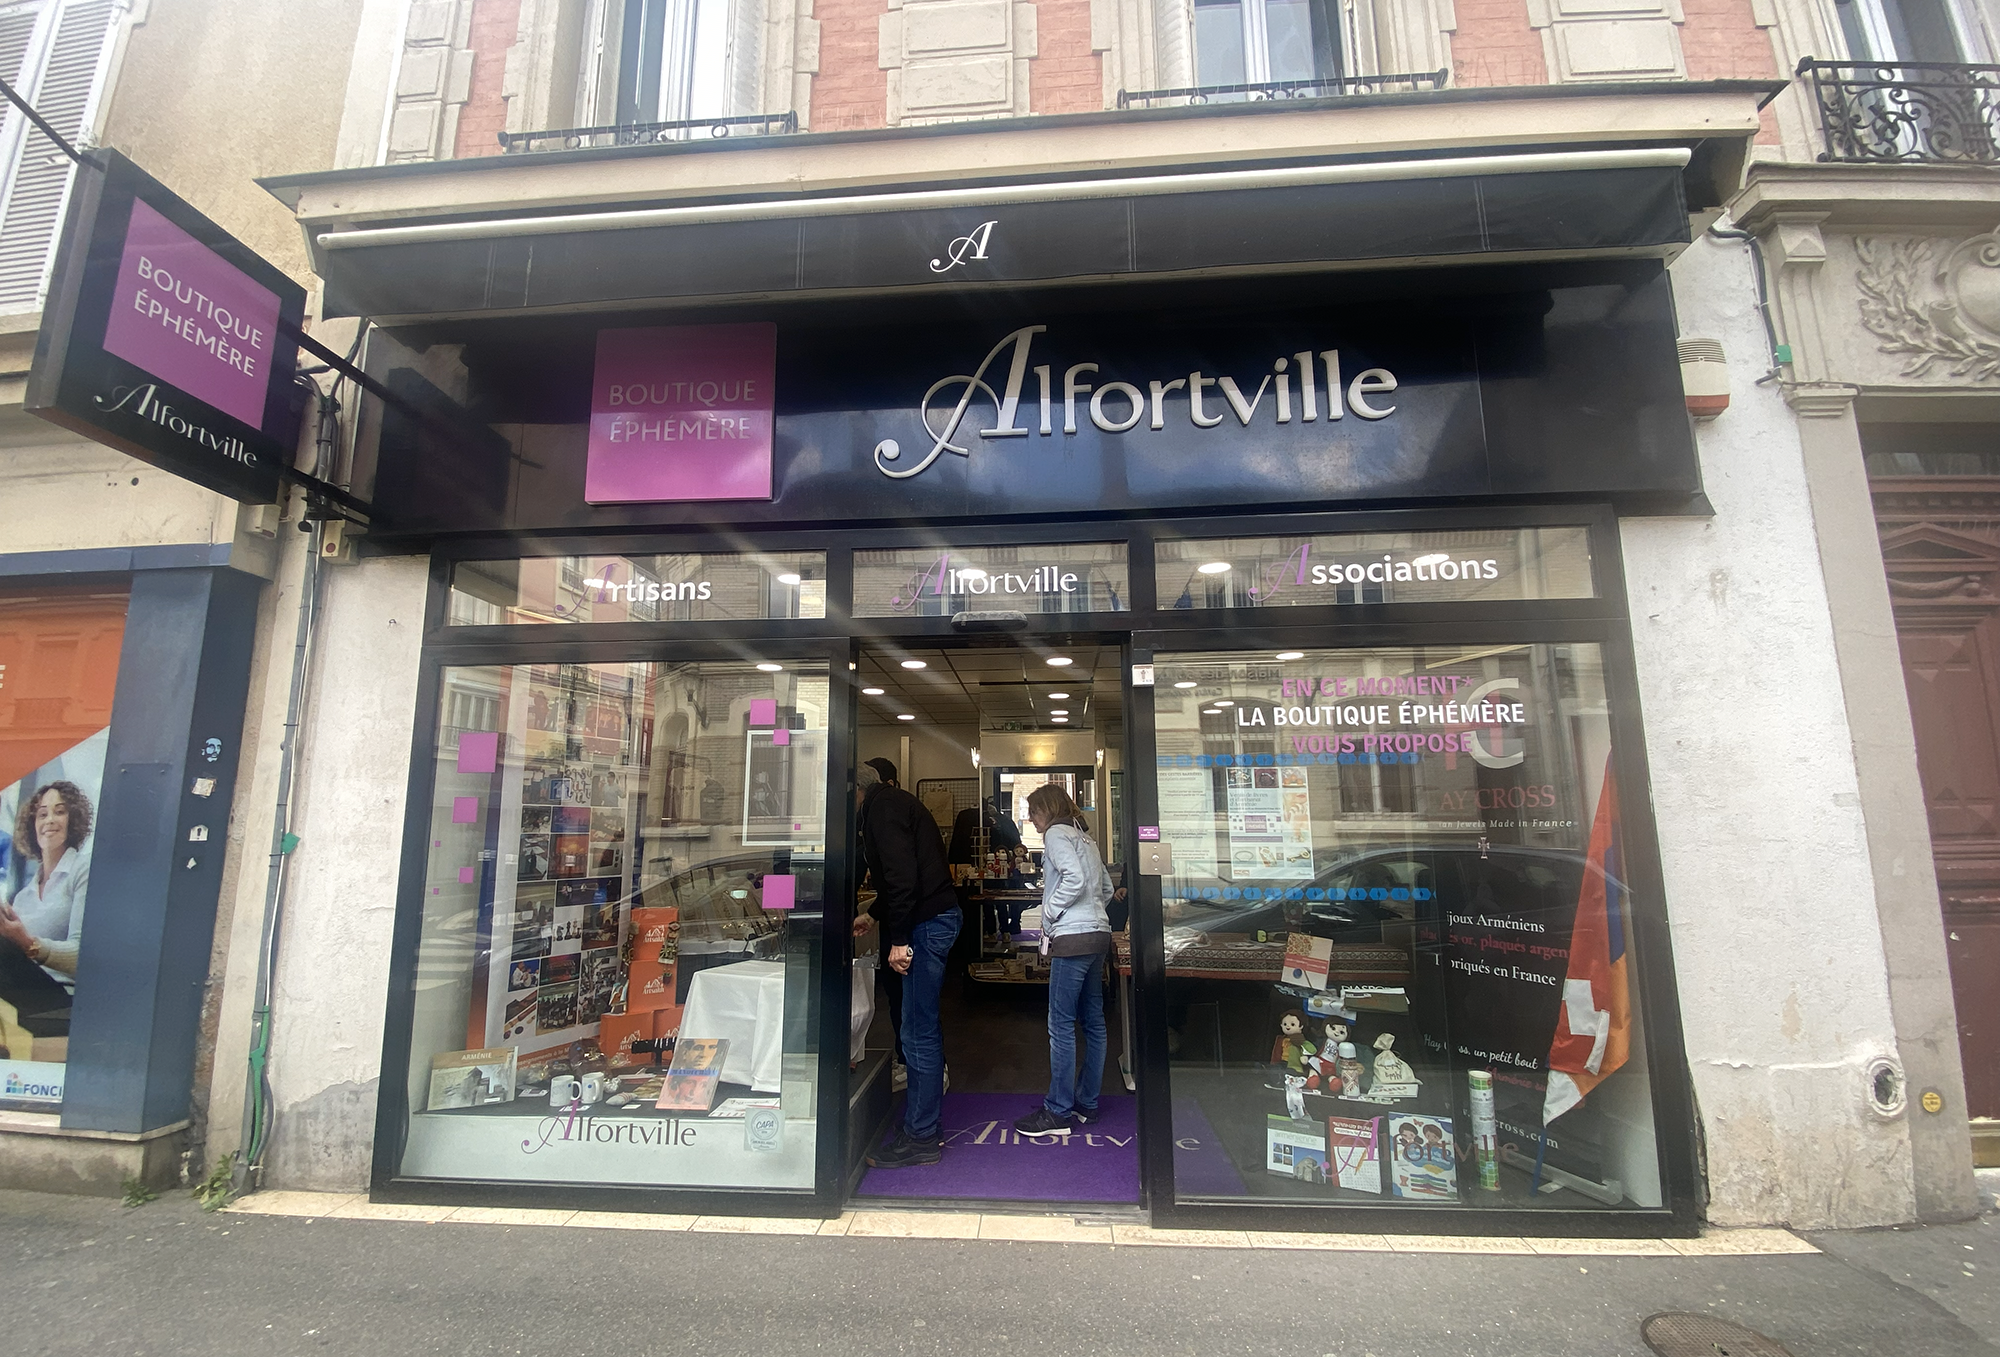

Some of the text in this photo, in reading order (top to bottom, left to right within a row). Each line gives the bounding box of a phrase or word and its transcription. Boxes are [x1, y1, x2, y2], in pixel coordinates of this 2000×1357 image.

[930, 221, 998, 272] A
[138, 257, 263, 350] BOUTIQUE
[134, 289, 256, 377] ÉPHÉMÈRE
[608, 380, 755, 407] BOUTIQUE
[874, 325, 1398, 478] Alfortville
[93, 383, 258, 468] Alfortville
[609, 412, 751, 443] ÉPHÉMÈRE
[890, 554, 1078, 611] Alfortville
[1248, 543, 1498, 601] Associations
[554, 563, 711, 617] Artisans
[1283, 679, 1311, 697] EN
[1320, 678, 1347, 697] CE
[1238, 700, 1525, 726] LA BOUTIQUE ÉPHÉMÈRE
[1292, 733, 1472, 754] VOUS PROPOSE
[1475, 785, 1556, 809] CROSS
[1490, 819, 1515, 828] Made
[1518, 820, 1528, 828] in
[1532, 818, 1572, 828] France
[1477, 914, 1545, 933] Arméniens
[1480, 934, 1526, 955] plaqués
[1529, 945, 1570, 960] argen
[1494, 966, 1509, 979] en
[1512, 965, 1556, 986] France
[461, 1052, 492, 1061] ARMÉNIE
[1474, 1049, 1488, 1059] un
[1489, 1051, 1513, 1063] petit
[1514, 1052, 1539, 1069] bout
[521, 1100, 698, 1154] Alfortville
